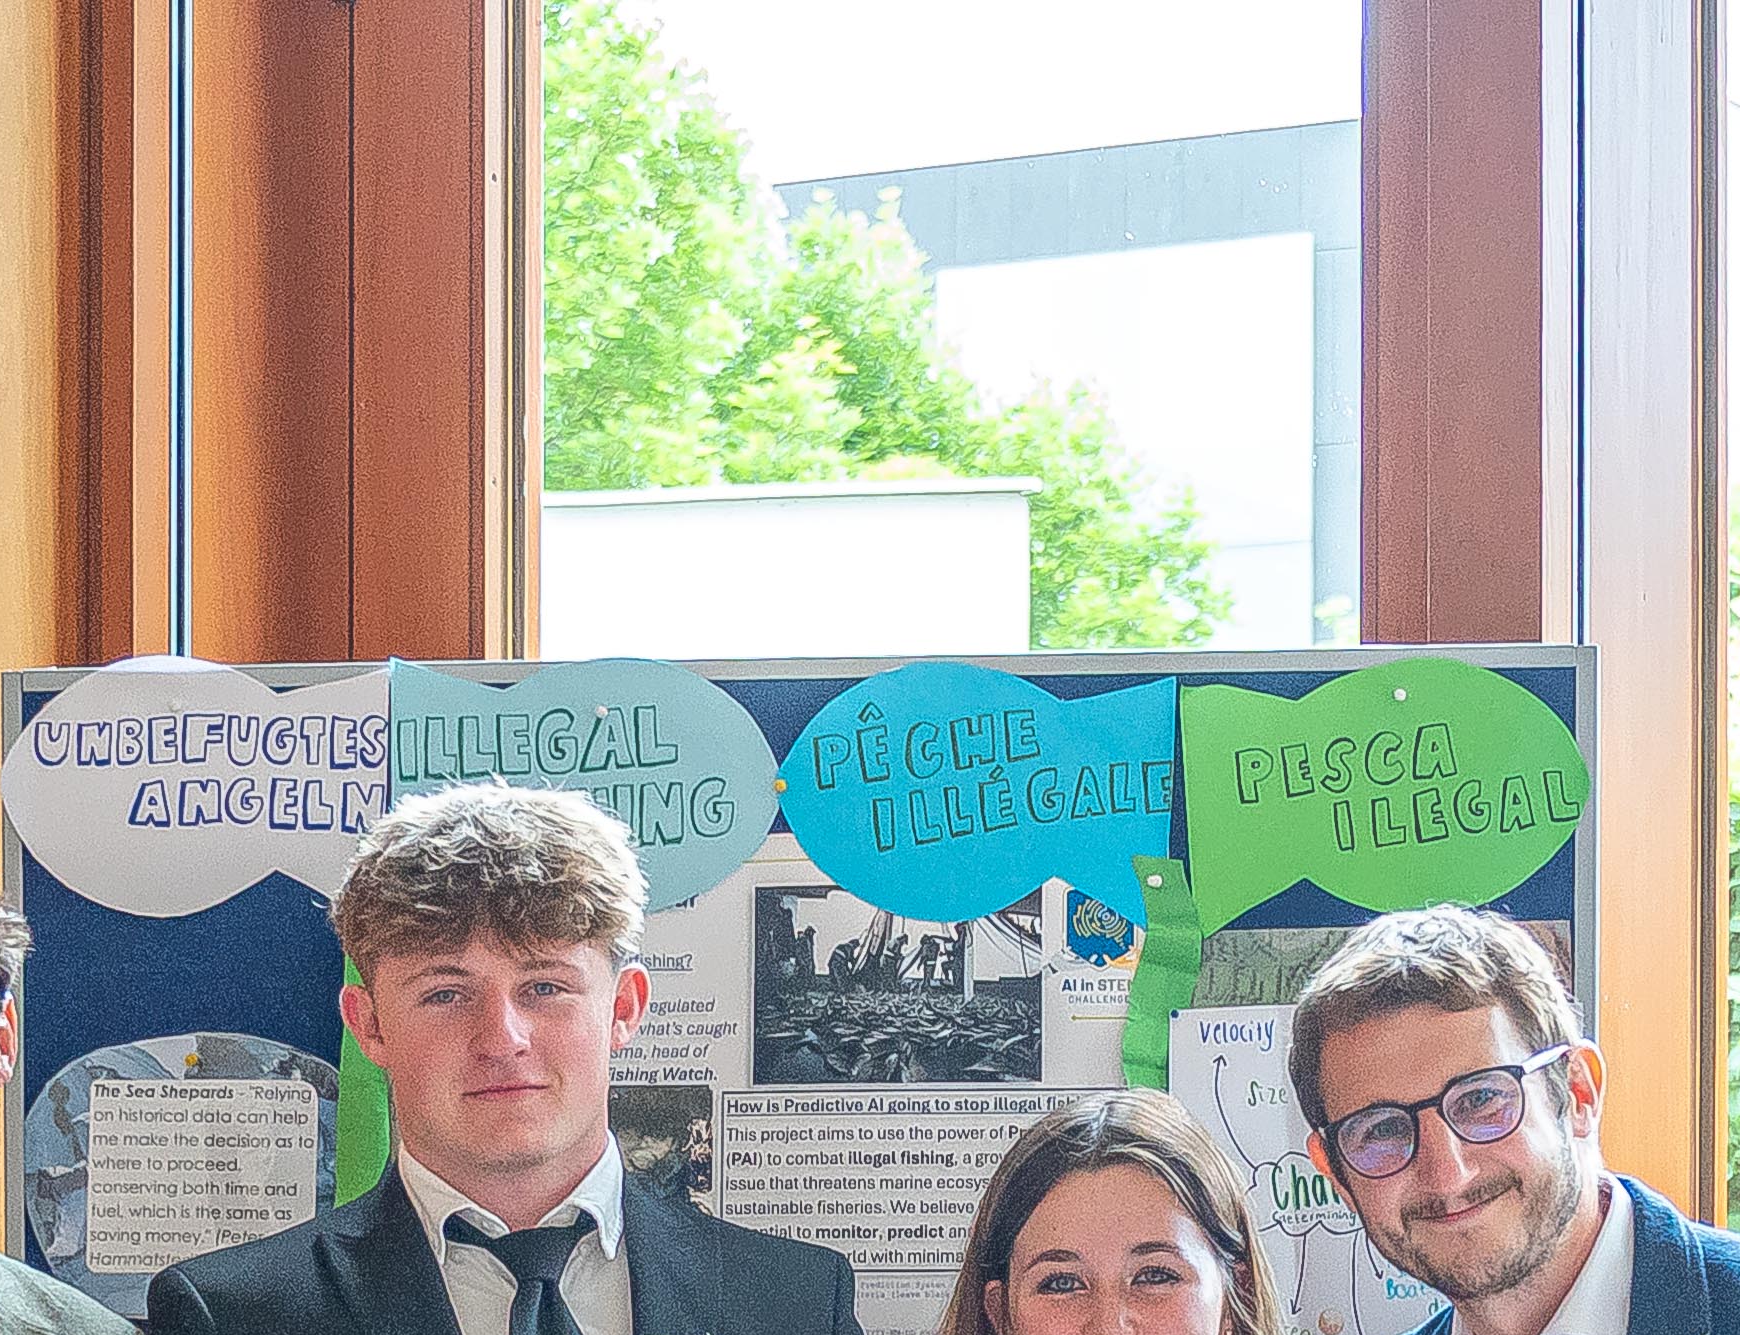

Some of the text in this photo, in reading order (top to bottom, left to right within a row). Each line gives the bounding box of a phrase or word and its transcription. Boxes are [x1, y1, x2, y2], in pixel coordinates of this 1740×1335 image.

[34, 712, 388, 768] UNBEFUGTES
[398, 706, 678, 782] ILLEGAL
[812, 705, 1040, 790] PÊCHE
[1236, 724, 1459, 805] PESCA
[871, 758, 1172, 852] ILLÉGALE
[1335, 771, 1581, 850] ILEGAL
[1062, 979, 1131, 992] AI in STE
[650, 999, 715, 1016] egulated
[687, 1022, 737, 1038] caught
[652, 1045, 690, 1058] head
[693, 1044, 709, 1058] of
[663, 1067, 718, 1080] Watch.
[94, 1084, 120, 1098] The
[125, 1084, 155, 1098] Sea
[160, 1084, 234, 1101] Shepards
[727, 1099, 762, 1114] How
[784, 1098, 863, 1113] Predictive
[868, 1098, 884, 1112] AI
[888, 1098, 930, 1113] going
[935, 1099, 950, 1112] to
[955, 1098, 989, 1113] stop
[994, 1097, 1042, 1113] illegal
[94, 1108, 309, 1128] on historical data can help
[93, 1132, 314, 1148] me make the decision as to
[727, 1128, 756, 1141] This
[761, 1127, 813, 1144] project
[818, 1127, 854, 1141] aims
[859, 1128, 873, 1140] to
[877, 1129, 905, 1140] use
[909, 1126, 933, 1140] the
[937, 1129, 985, 1142] power
[990, 1126, 1004, 1139] of
[93, 1157, 142, 1170] where
[147, 1157, 163, 1171] to
[726, 1152, 762, 1169] (PAI)
[767, 1153, 781, 1165] to
[786, 1152, 844, 1165] combat
[849, 1151, 896, 1168] illegal
[901, 1151, 958, 1167] fishing,
[963, 1153, 971, 1165] a
[92, 1181, 298, 1197] conserving both time and
[726, 1175, 990, 1191] issue that threatens marine ecosys
[129, 1205, 176, 1219] which
[180, 1206, 190, 1219] is
[195, 1207, 221, 1220] the
[226, 1208, 269, 1220] same
[274, 1209, 292, 1220] as
[725, 1200, 974, 1215] sustainable fisheries. We believe
[90, 1229, 140, 1245] saving
[797, 1226, 810, 1238] to
[815, 1225, 883, 1240] monitor,
[887, 1225, 944, 1241] predict
[949, 1227, 967, 1238] an
[871, 1249, 903, 1263] with
[909, 1249, 964, 1264] minima
